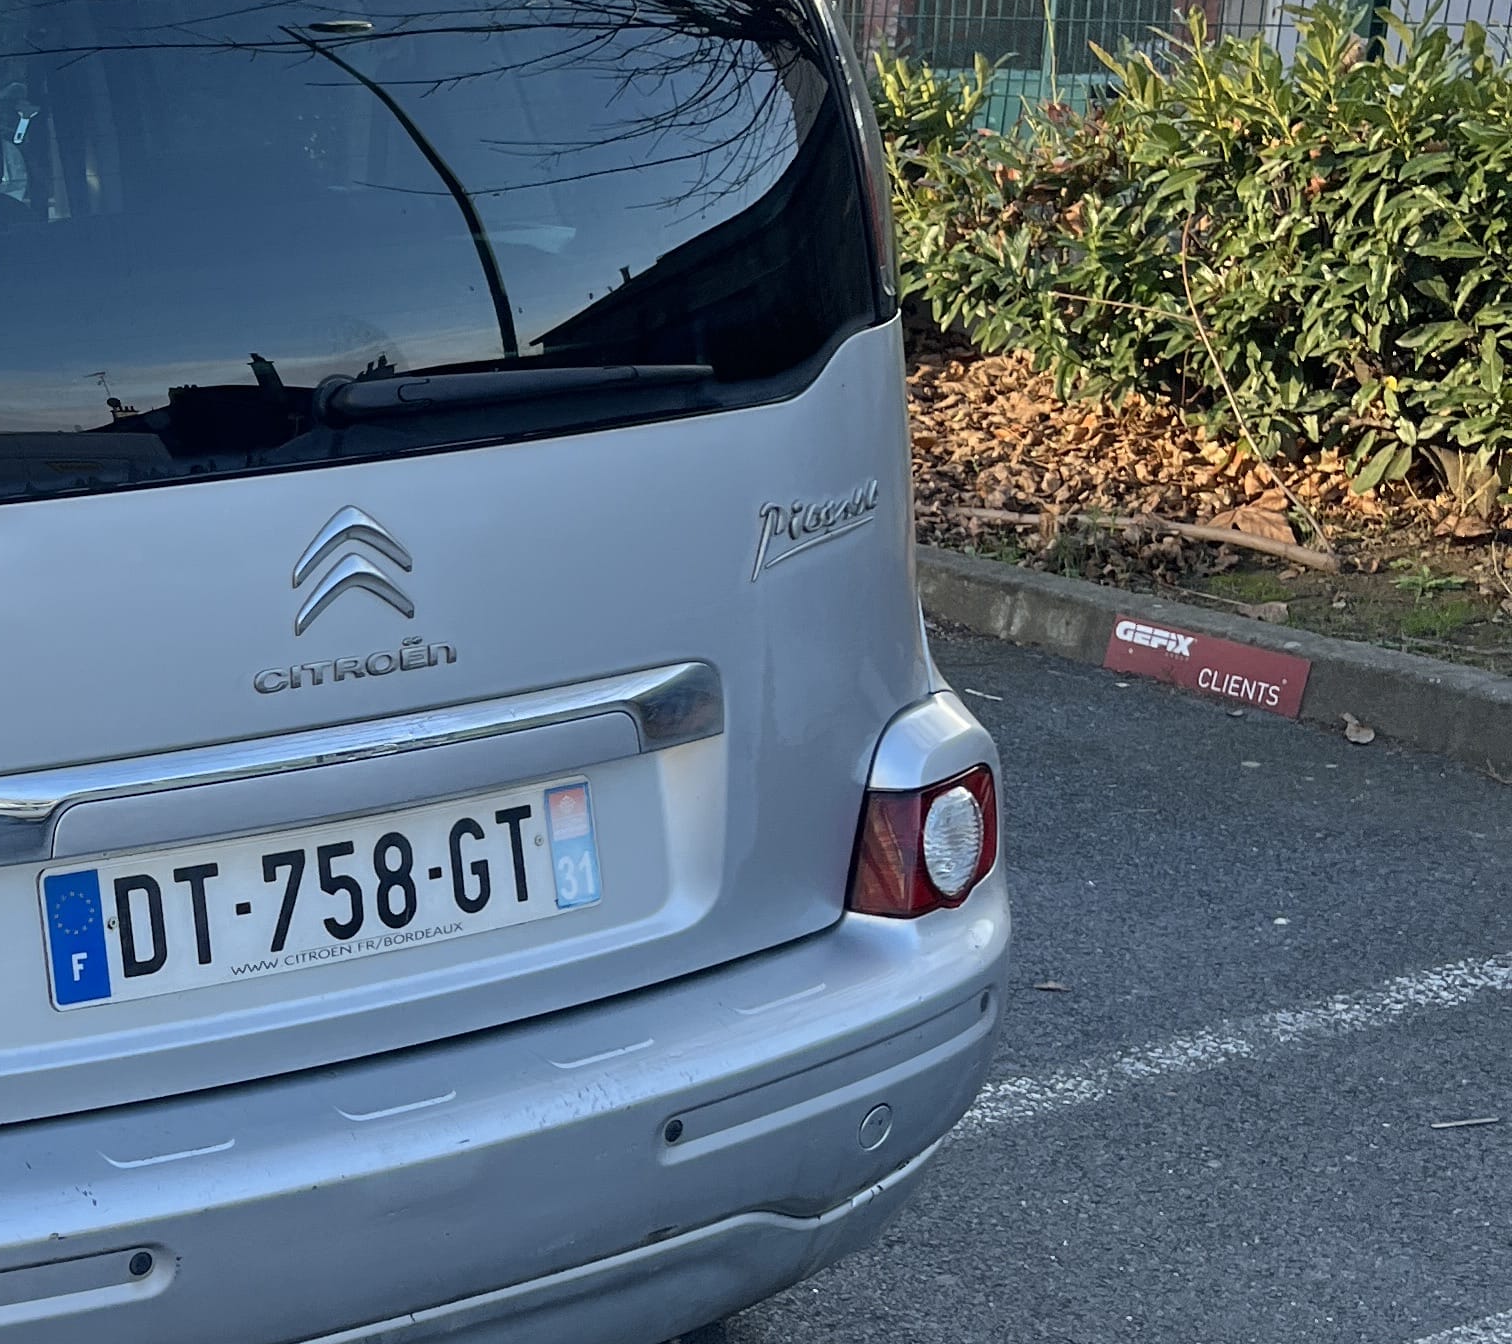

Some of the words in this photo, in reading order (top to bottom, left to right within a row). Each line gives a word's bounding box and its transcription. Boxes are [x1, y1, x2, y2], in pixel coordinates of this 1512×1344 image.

[1198, 668, 1281, 707] CLIENTS
[113, 804, 532, 978] DT-758-GT
[557, 850, 596, 900] 31
[71, 951, 89, 982] F
